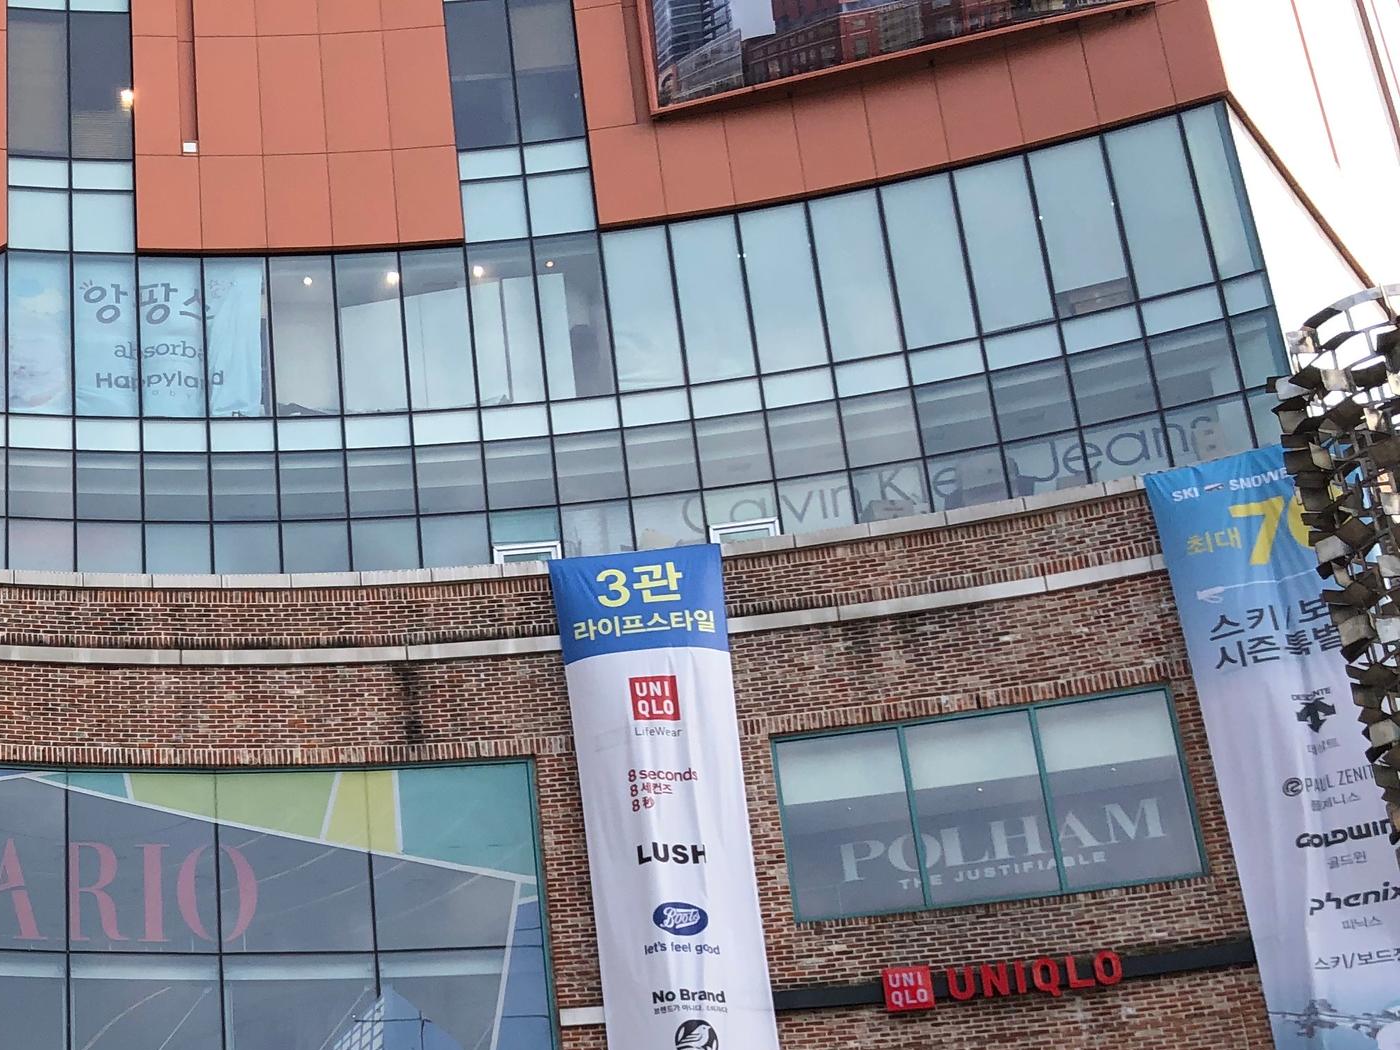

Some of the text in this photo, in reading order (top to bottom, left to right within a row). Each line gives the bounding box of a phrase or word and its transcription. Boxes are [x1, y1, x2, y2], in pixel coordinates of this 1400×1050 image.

[1172, 487, 1200, 502] SKI
[682, 478, 860, 535] Cavin
[1186, 526, 1243, 556] 최대
[596, 561, 683, 607] 3관
[574, 610, 716, 641] 라이프스타일
[635, 681, 671, 697] UNI
[638, 699, 675, 717] QLO
[634, 726, 682, 737] LifeWear
[628, 767, 698, 782] 8 seconds
[630, 783, 672, 796] 8 세컨즈
[1304, 774, 1335, 793] PAUL
[632, 799, 640, 812] 8
[839, 798, 1167, 882] POLHAM
[637, 842, 706, 865] LUSH
[899, 876, 942, 890] THE
[644, 942, 720, 956] let's feel good
[887, 971, 923, 987] UNI
[946, 949, 1124, 1001] UNIQLO
[652, 988, 726, 1004] No Brand
[890, 988, 929, 1006] QLO
